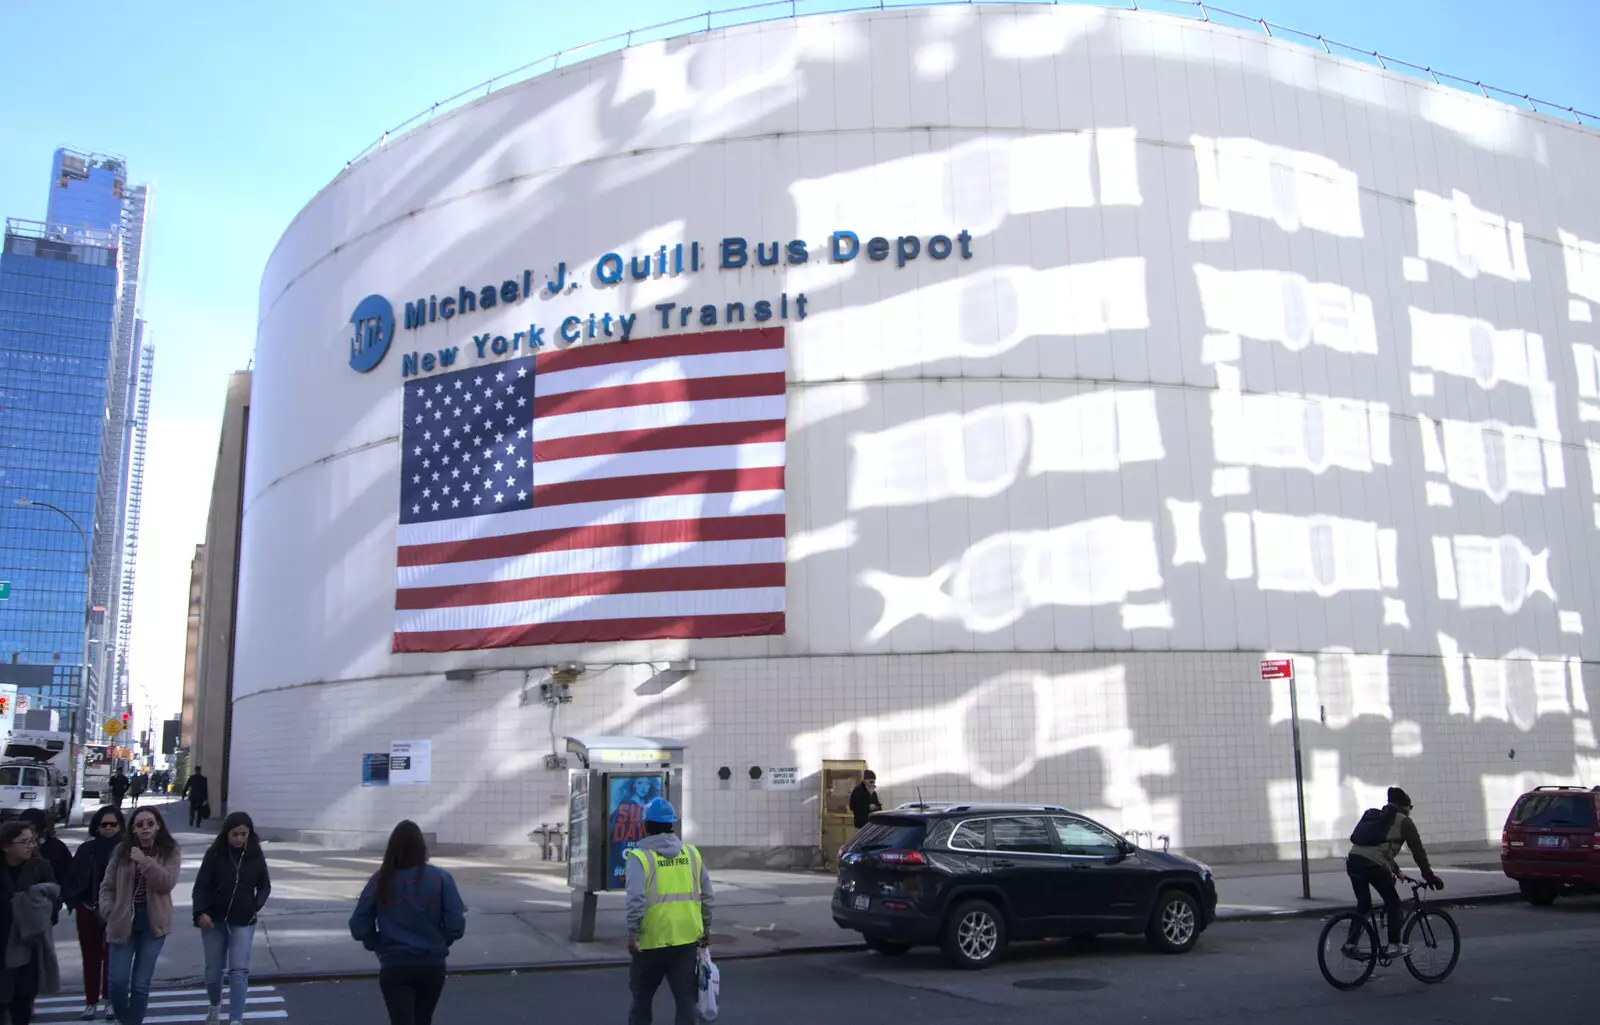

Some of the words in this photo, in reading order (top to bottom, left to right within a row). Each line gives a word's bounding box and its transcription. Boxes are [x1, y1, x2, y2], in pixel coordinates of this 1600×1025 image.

[404, 270, 532, 330] Michael
[547, 261, 579, 293] J.
[596, 242, 700, 284] Quill
[721, 236, 809, 269] Bus
[831, 229, 974, 267] Depot
[402, 345, 459, 377] New
[472, 323, 545, 359] York
[560, 312, 637, 343] City
[654, 292, 808, 329] Transit
[675, 857, 690, 866] FREE
